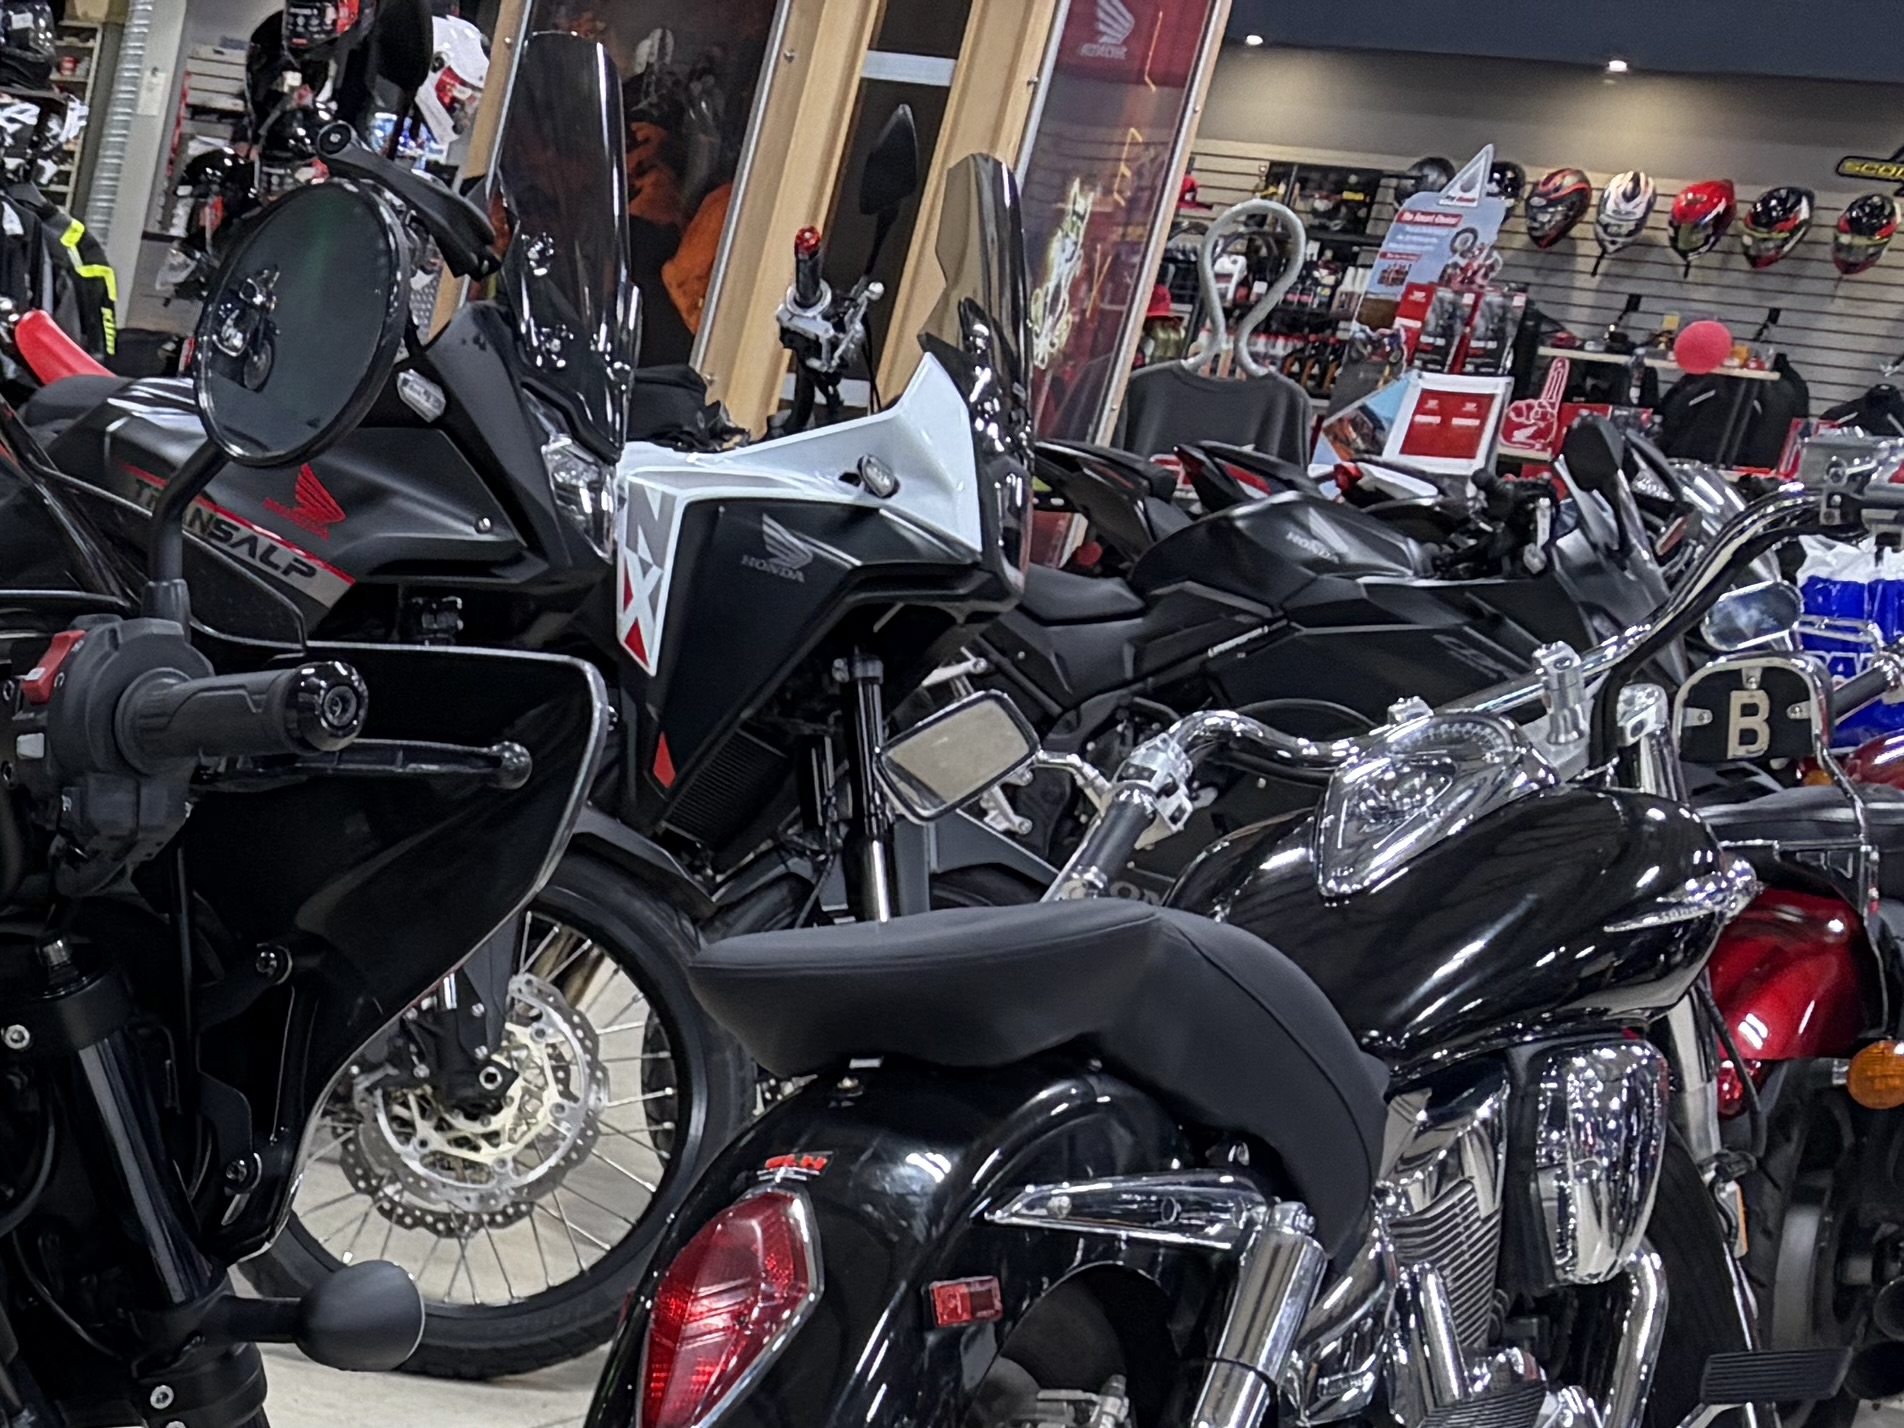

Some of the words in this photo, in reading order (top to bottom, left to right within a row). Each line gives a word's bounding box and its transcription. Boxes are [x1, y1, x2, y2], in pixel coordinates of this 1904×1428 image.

[134, 478, 318, 579] TNSALP
[1285, 531, 1339, 564] HONDA
[741, 554, 805, 583] HONDA
[1727, 690, 1770, 760] B
